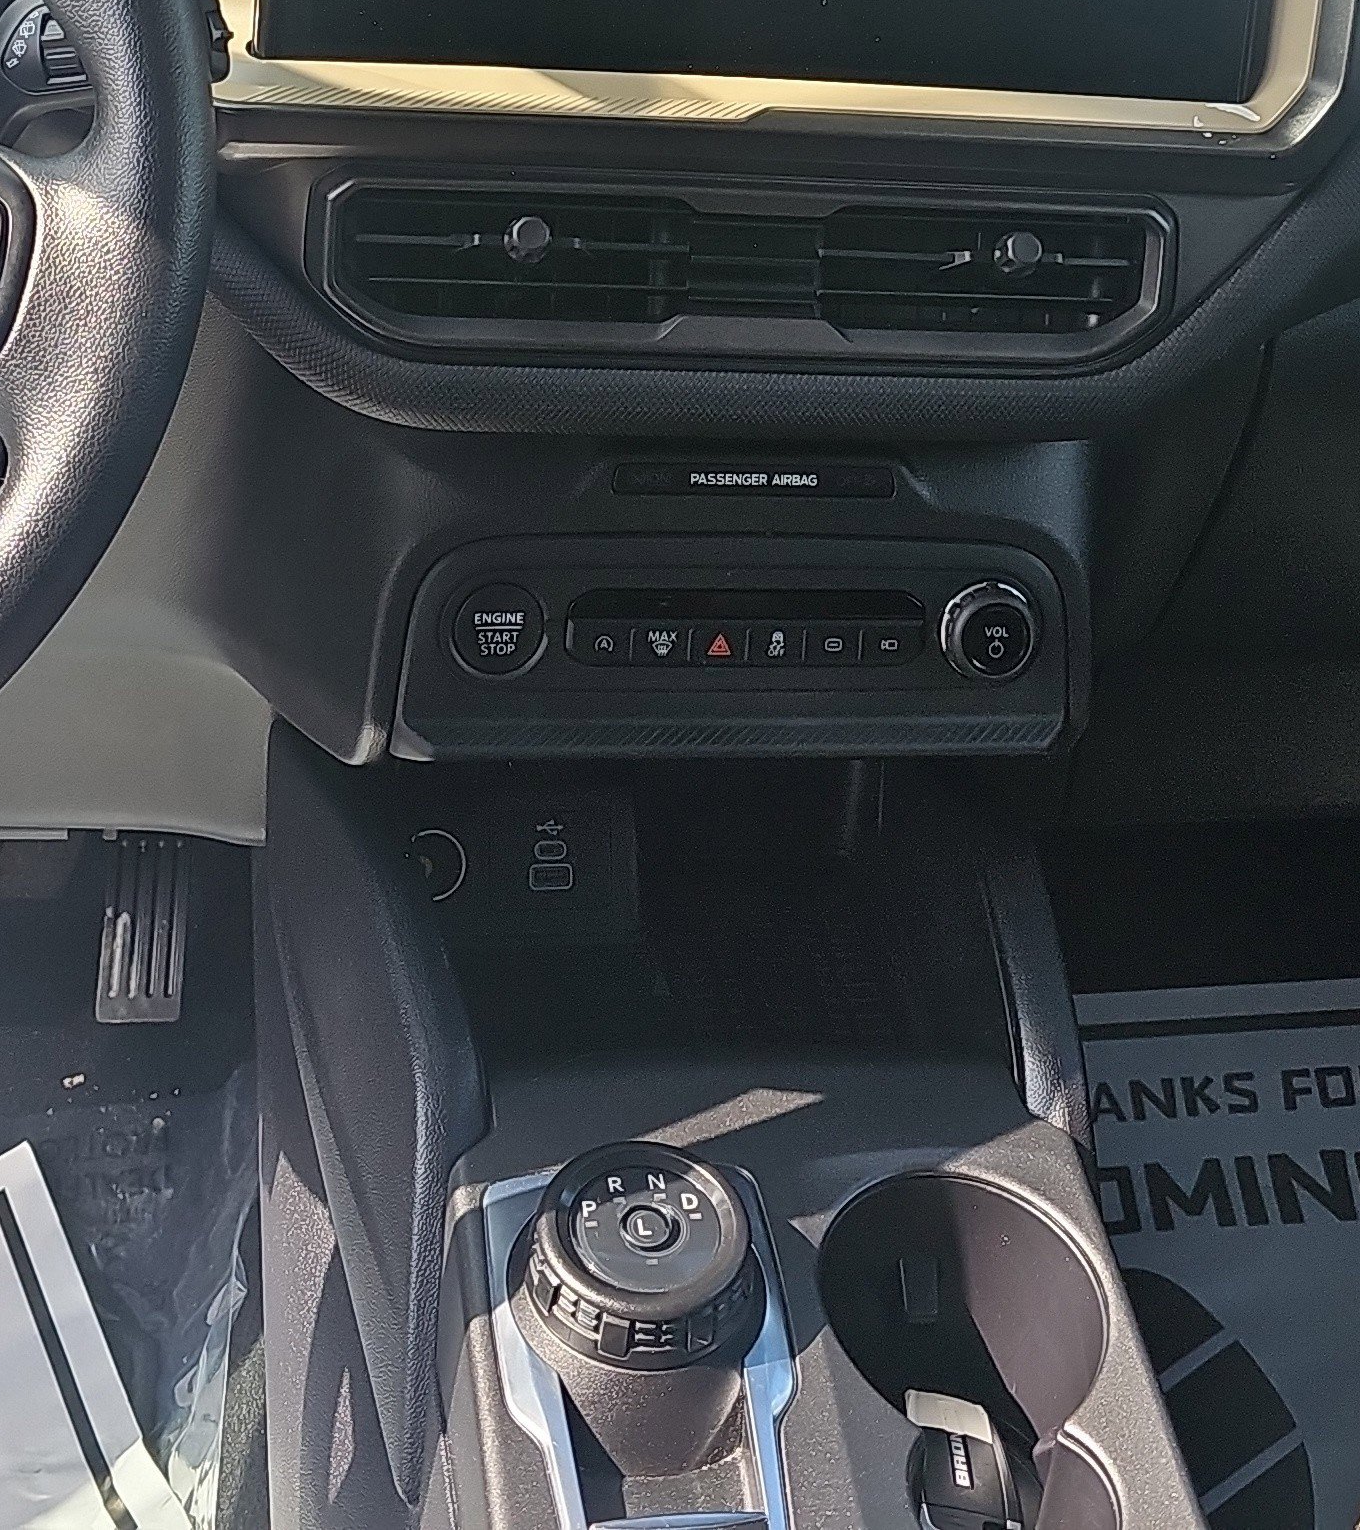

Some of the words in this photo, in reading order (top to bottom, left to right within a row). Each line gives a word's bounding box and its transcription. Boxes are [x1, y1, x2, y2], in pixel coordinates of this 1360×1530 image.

[690, 473, 768, 486] PASSENGER
[771, 473, 818, 487] AIRBAG
[474, 612, 525, 624] ENGINE
[477, 631, 519, 643] START
[648, 631, 677, 643] MAX
[985, 627, 1009, 638] VOL
[480, 643, 516, 656] STOP
[767, 648, 785, 657] OFF
[1091, 1071, 1260, 1123] ANKS
[582, 1200, 597, 1218] P
[607, 1177, 624, 1193] R
[647, 1173, 666, 1190] N
[680, 1193, 698, 1210] D
[637, 1218, 652, 1236] L
